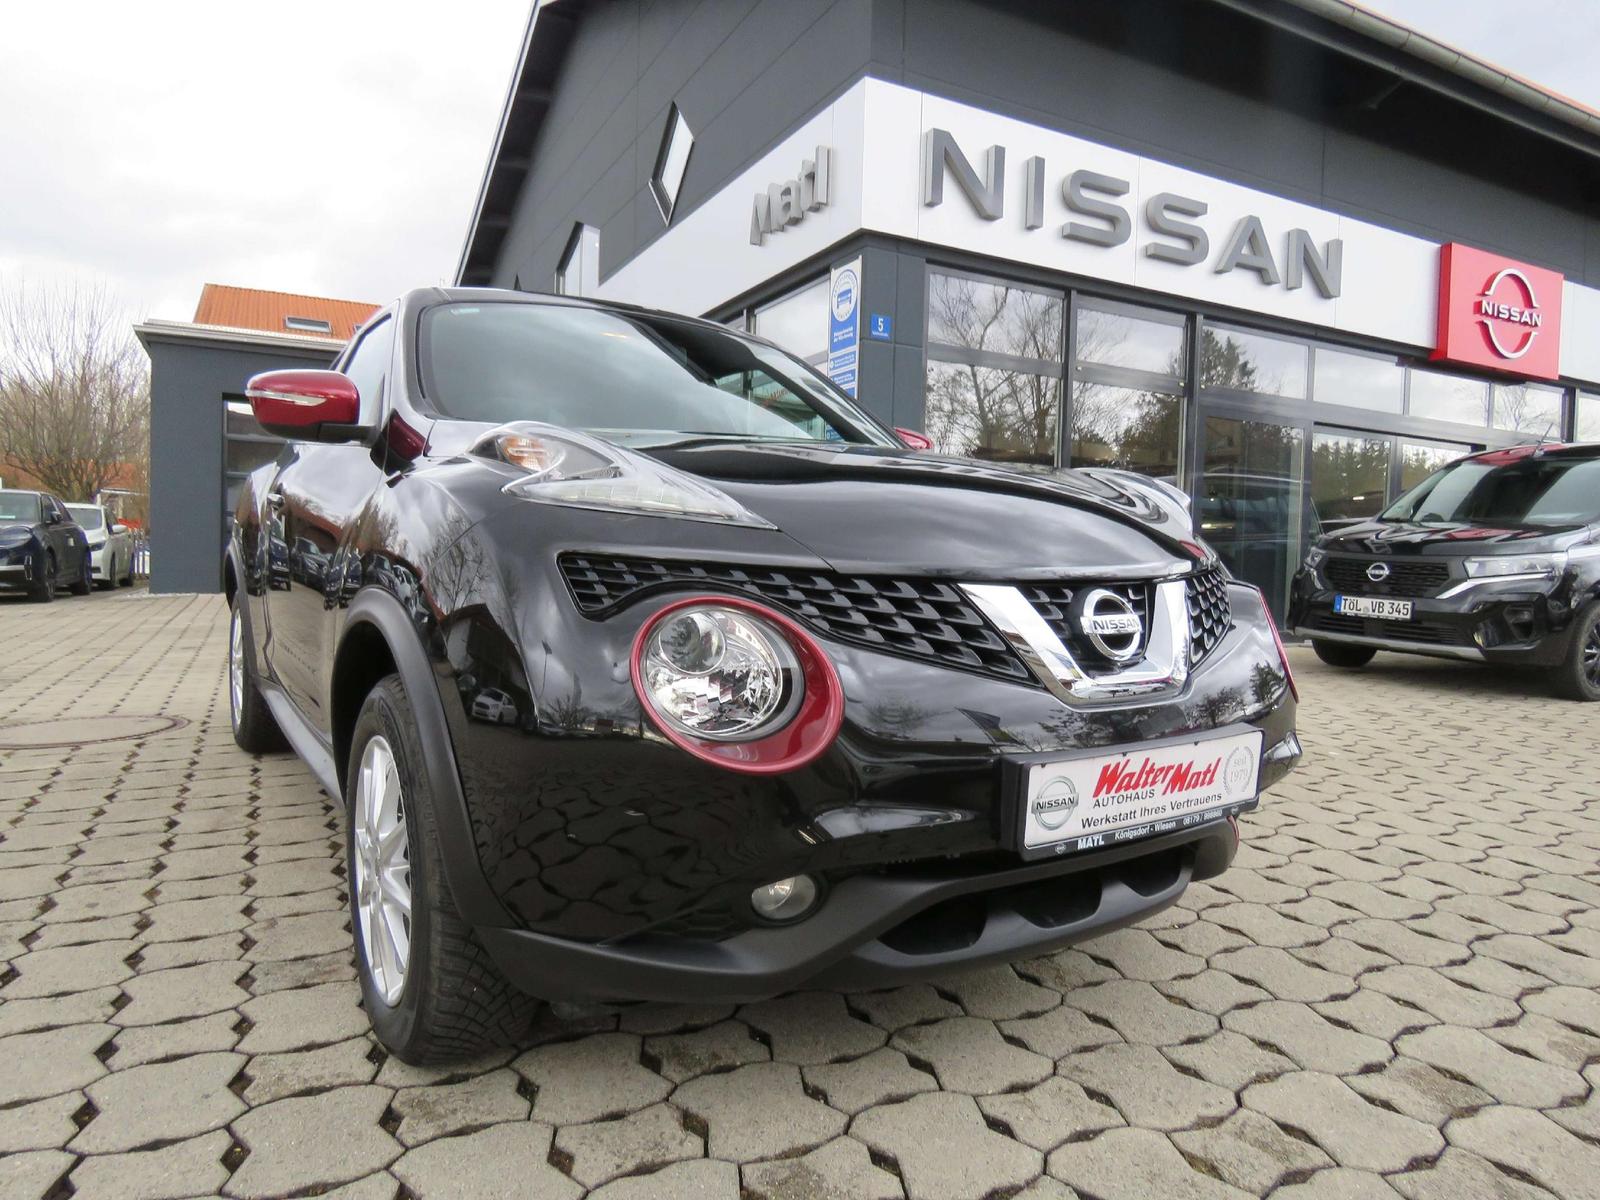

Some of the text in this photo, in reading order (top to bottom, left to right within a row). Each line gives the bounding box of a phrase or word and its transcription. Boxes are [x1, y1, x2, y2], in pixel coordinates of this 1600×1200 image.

[923, 127, 1343, 298] NISSAN
[1481, 299, 1542, 327] NISSAN
[877, 317, 884, 332] 5
[1343, 598, 1362, 612] TÖL
[1371, 601, 1385, 614] VB
[1388, 602, 1409, 616] 345
[1093, 618, 1139, 630] NISSAN
[1093, 757, 1222, 798] Walter Matl
[1036, 796, 1075, 811] NISSAN
[1093, 788, 1155, 809] AUTOHAUS
[1081, 793, 1222, 829] Werkstatt Ihres Vertrauens
[1077, 835, 1105, 850] MATL
